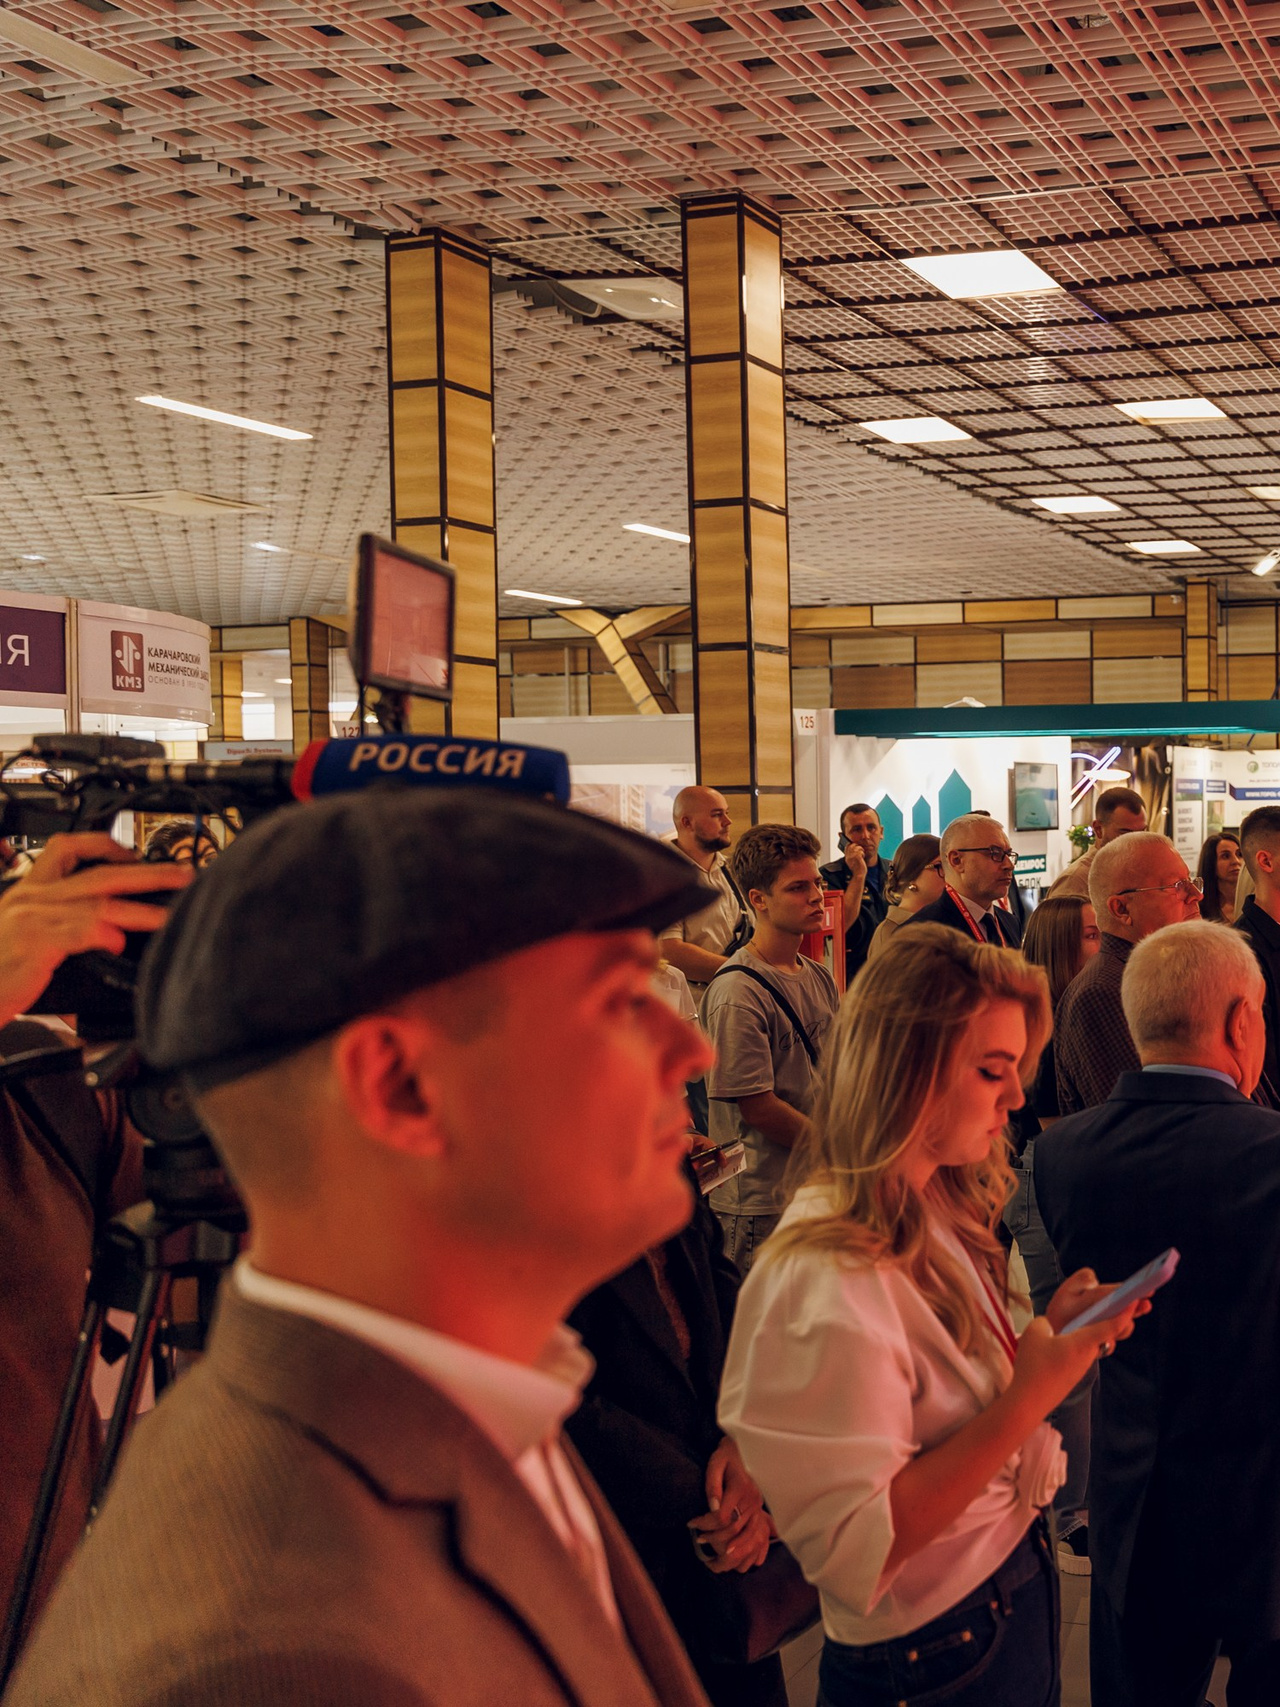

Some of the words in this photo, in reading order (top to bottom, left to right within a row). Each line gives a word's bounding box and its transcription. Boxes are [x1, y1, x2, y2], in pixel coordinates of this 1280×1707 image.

[0, 632, 30, 668] Я
[148, 647, 202, 665] КАРАЧАРОВСКИЙ
[148, 662, 200, 678] МЕХАНИЧЕСКИЙ
[116, 675, 142, 688] КМЗ
[800, 715, 814, 729] 125
[342, 726, 360, 738] 127
[349, 742, 526, 778] РОССИЯ
